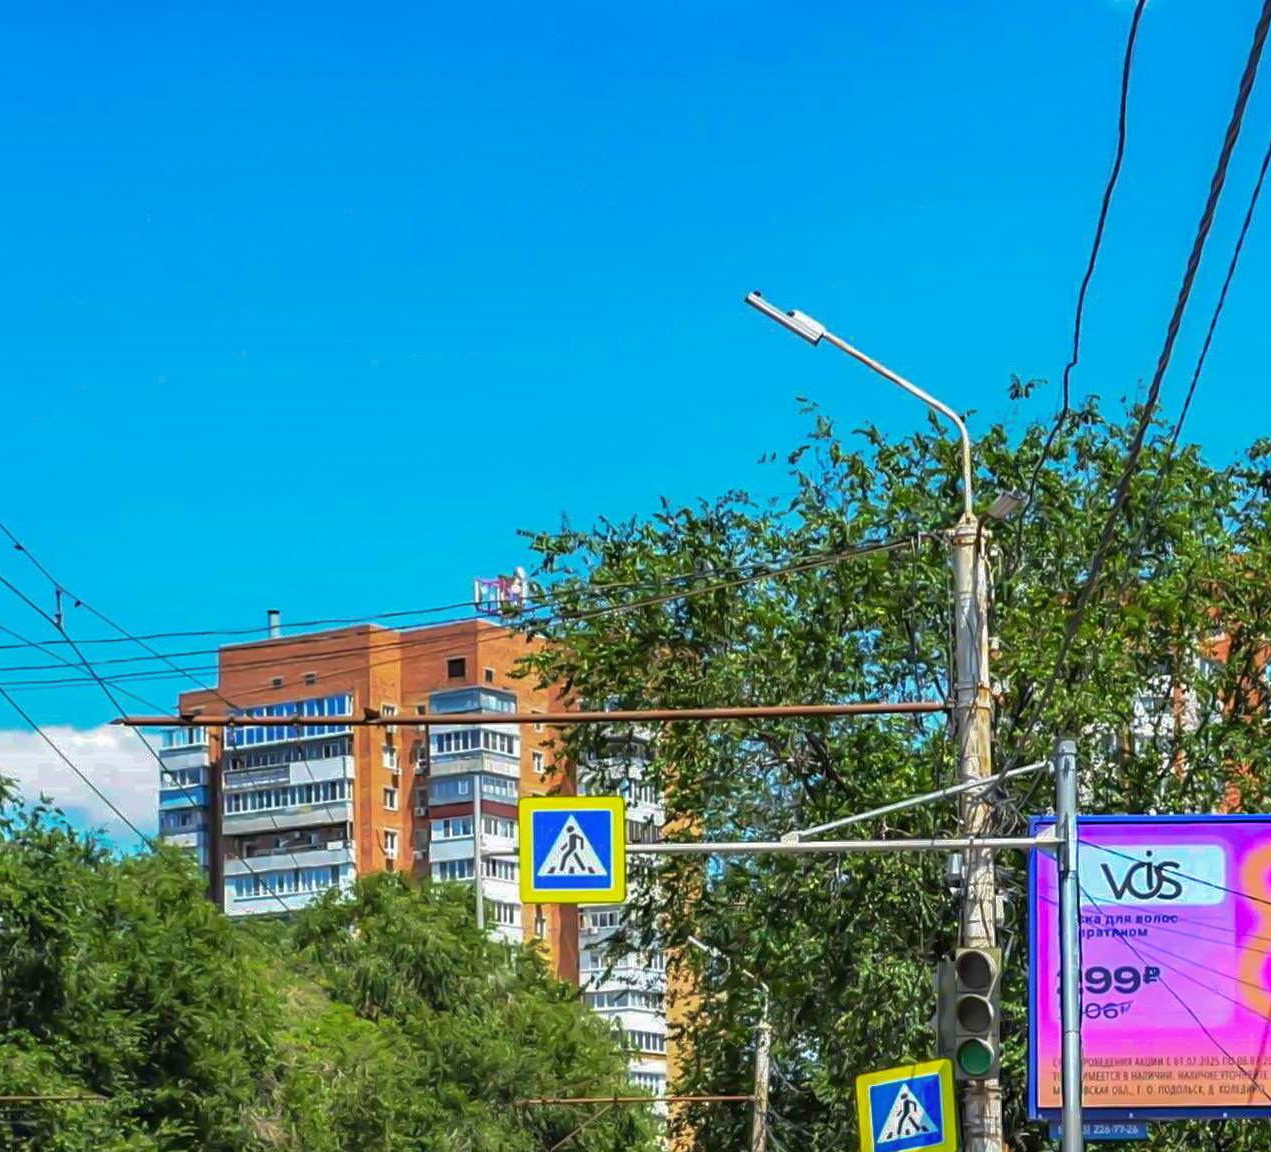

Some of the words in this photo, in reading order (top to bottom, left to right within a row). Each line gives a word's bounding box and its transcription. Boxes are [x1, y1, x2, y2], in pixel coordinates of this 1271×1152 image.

[1105, 914, 1132, 926] для
[1135, 913, 1179, 924] волос
[1083, 1057, 1132, 1067] РОВЕДЕНИЯ
